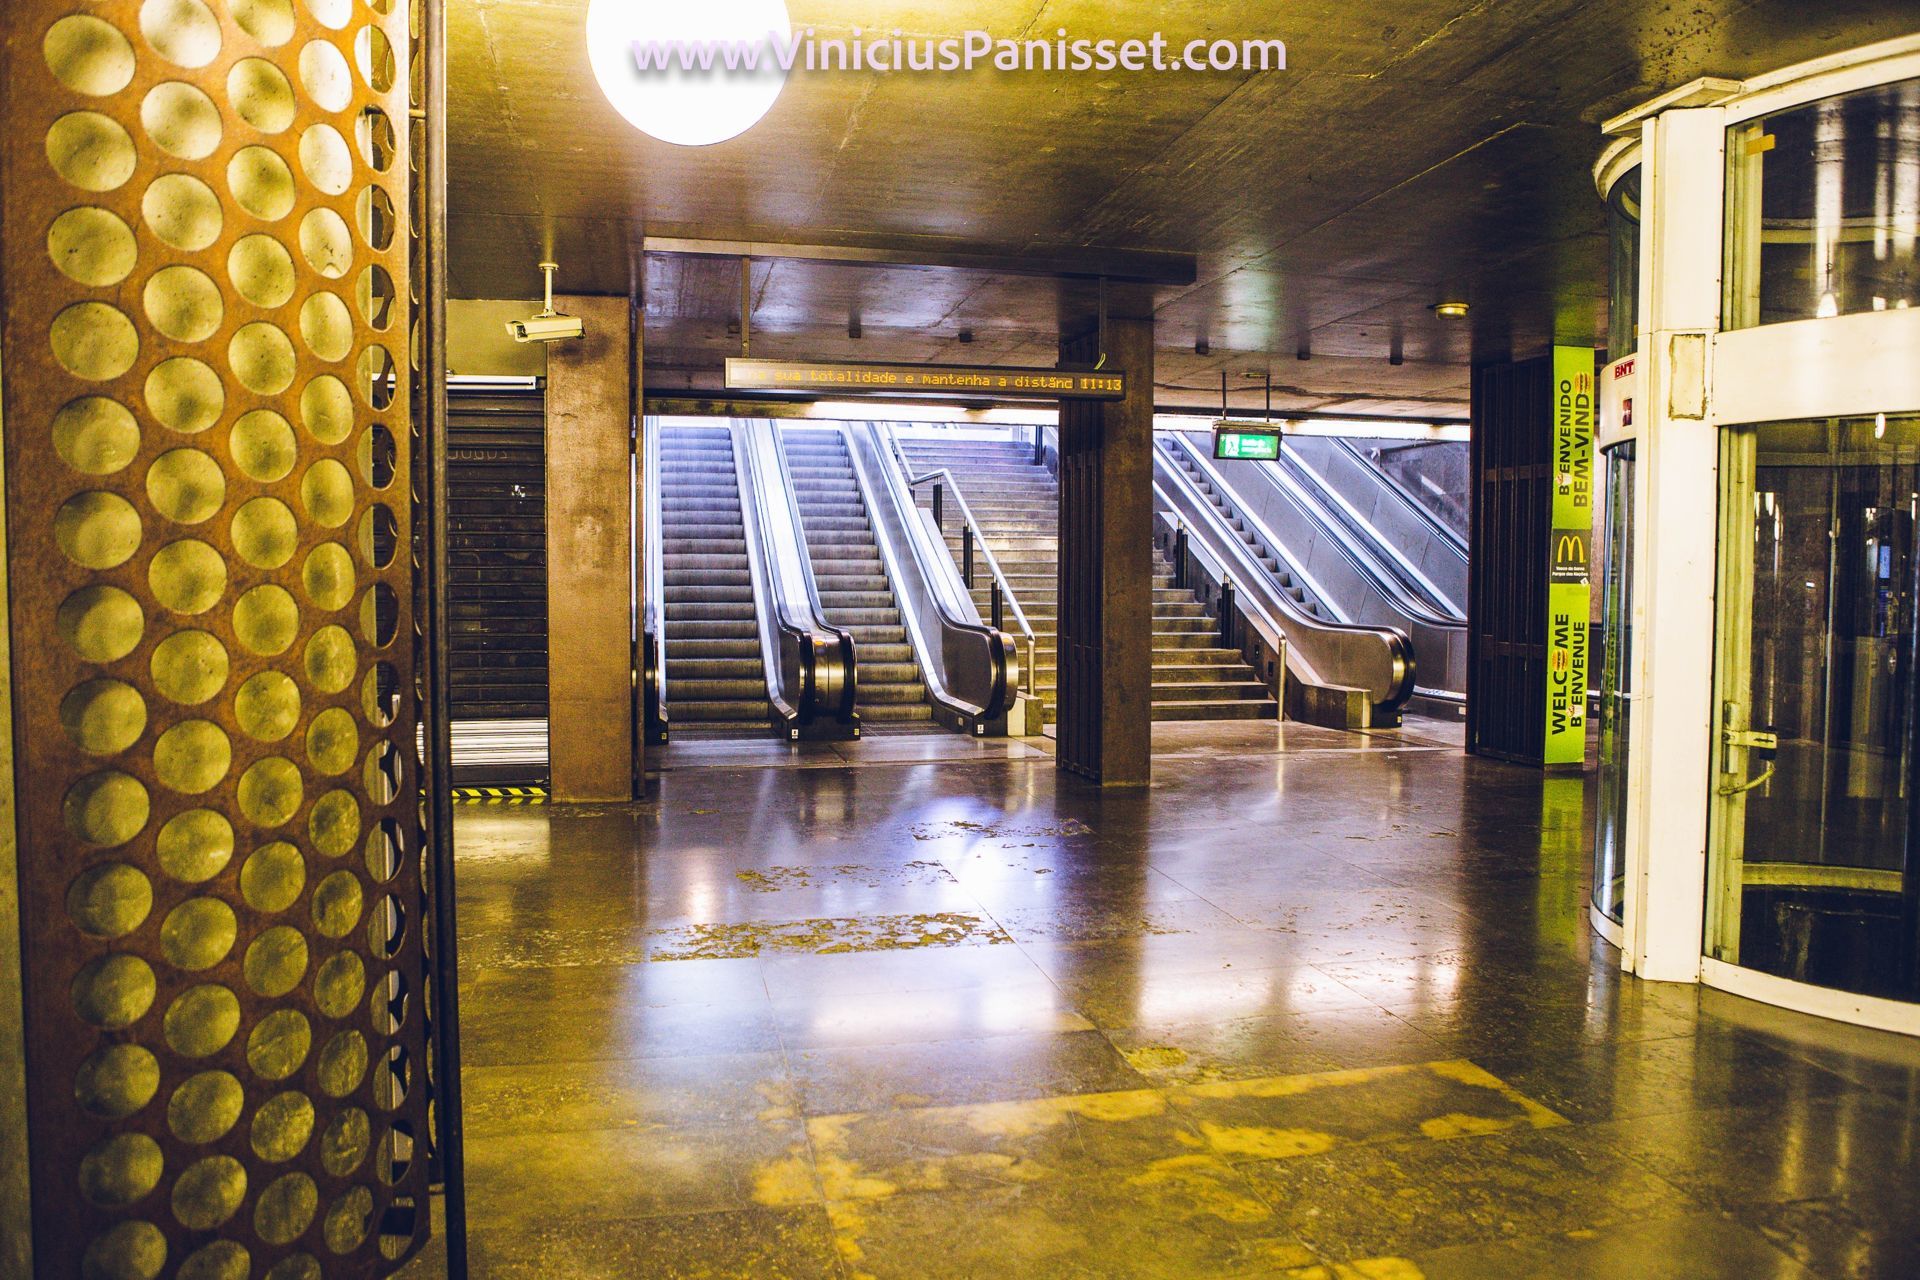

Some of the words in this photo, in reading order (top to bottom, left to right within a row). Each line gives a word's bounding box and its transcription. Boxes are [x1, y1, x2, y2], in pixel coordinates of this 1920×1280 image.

[810, 371, 897, 384] totalidade
[905, 375, 914, 384] e
[922, 374, 990, 386] mantenha
[998, 378, 1007, 387] a
[1081, 378, 1122, 391] 11:13
[1559, 380, 1572, 496] BENVENIDO
[1574, 372, 1590, 508] BEM-VIND
[1552, 613, 1569, 736] WELCME
[1570, 621, 1586, 728] BENVENUE
